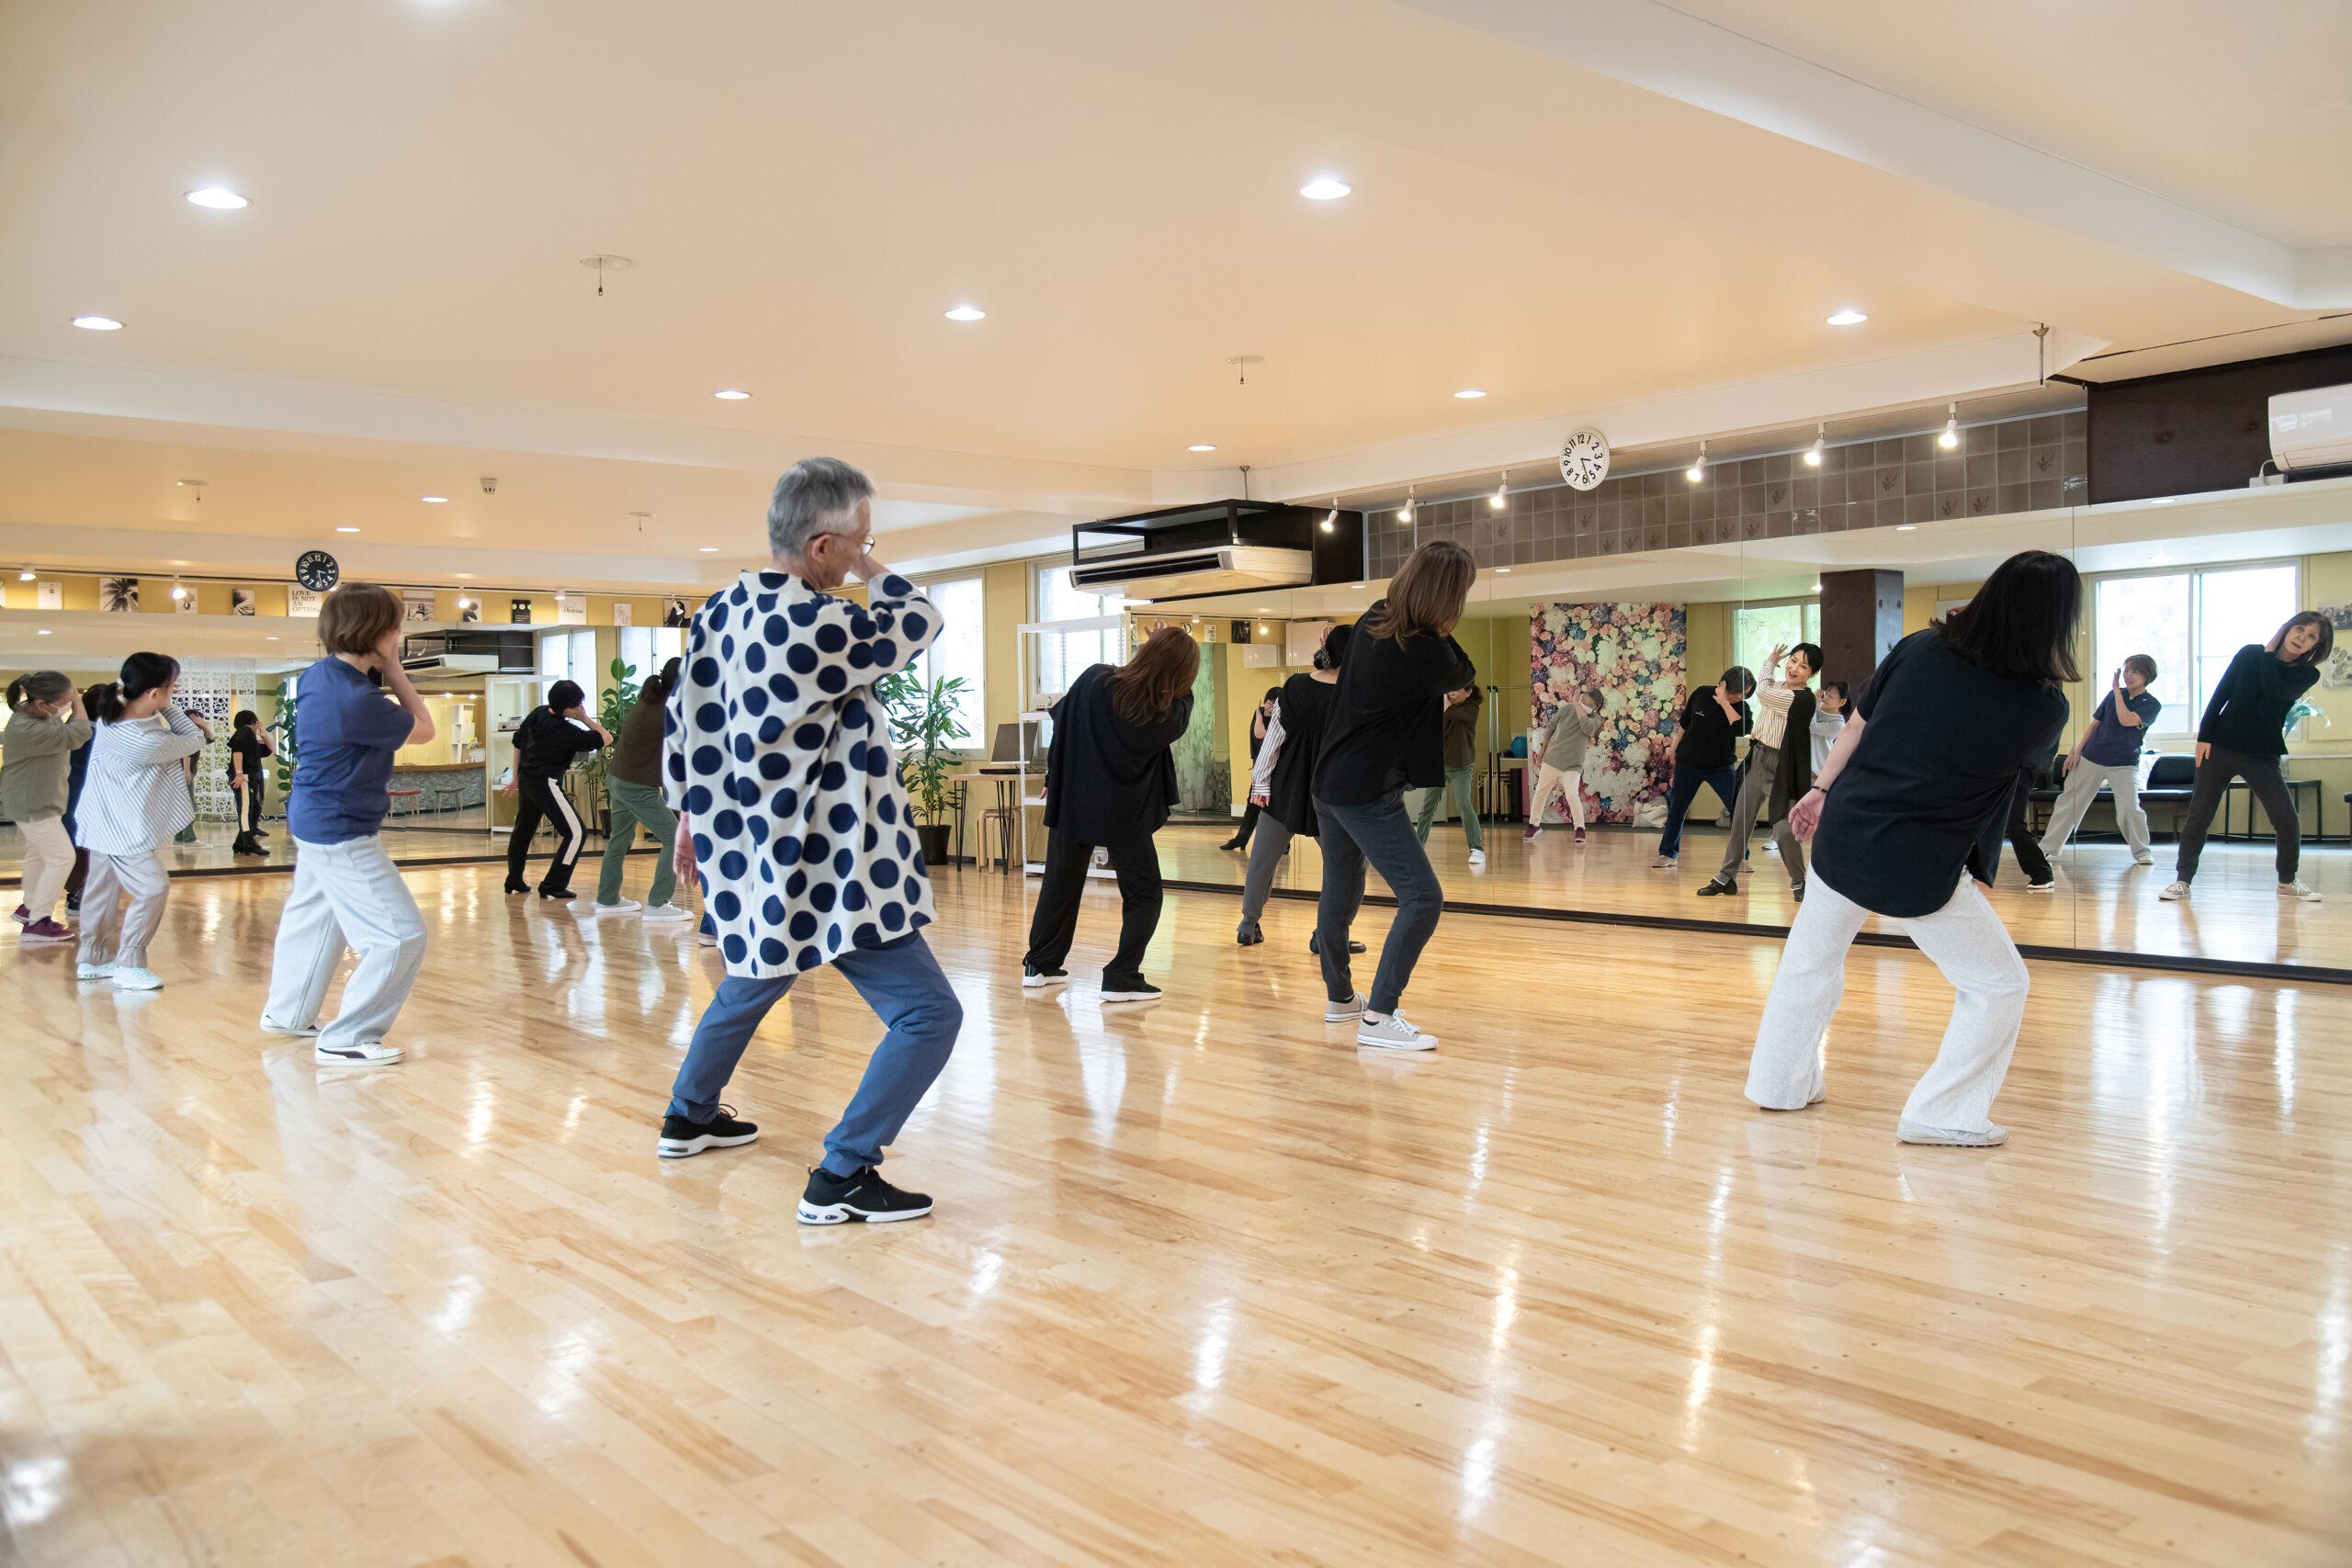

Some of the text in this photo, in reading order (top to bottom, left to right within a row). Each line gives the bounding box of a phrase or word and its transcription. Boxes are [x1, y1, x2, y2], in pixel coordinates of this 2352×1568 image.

[1569, 439, 1577, 448] 11
[1577, 434, 1585, 444] 12
[1587, 435, 1591, 445] 1
[1591, 442, 1600, 451] 2
[1564, 447, 1572, 457] 10
[1566, 468, 1574, 477] 8
[1589, 470, 1596, 479] 5
[1574, 473, 1579, 482] 7
[1582, 475, 1588, 484] 6
